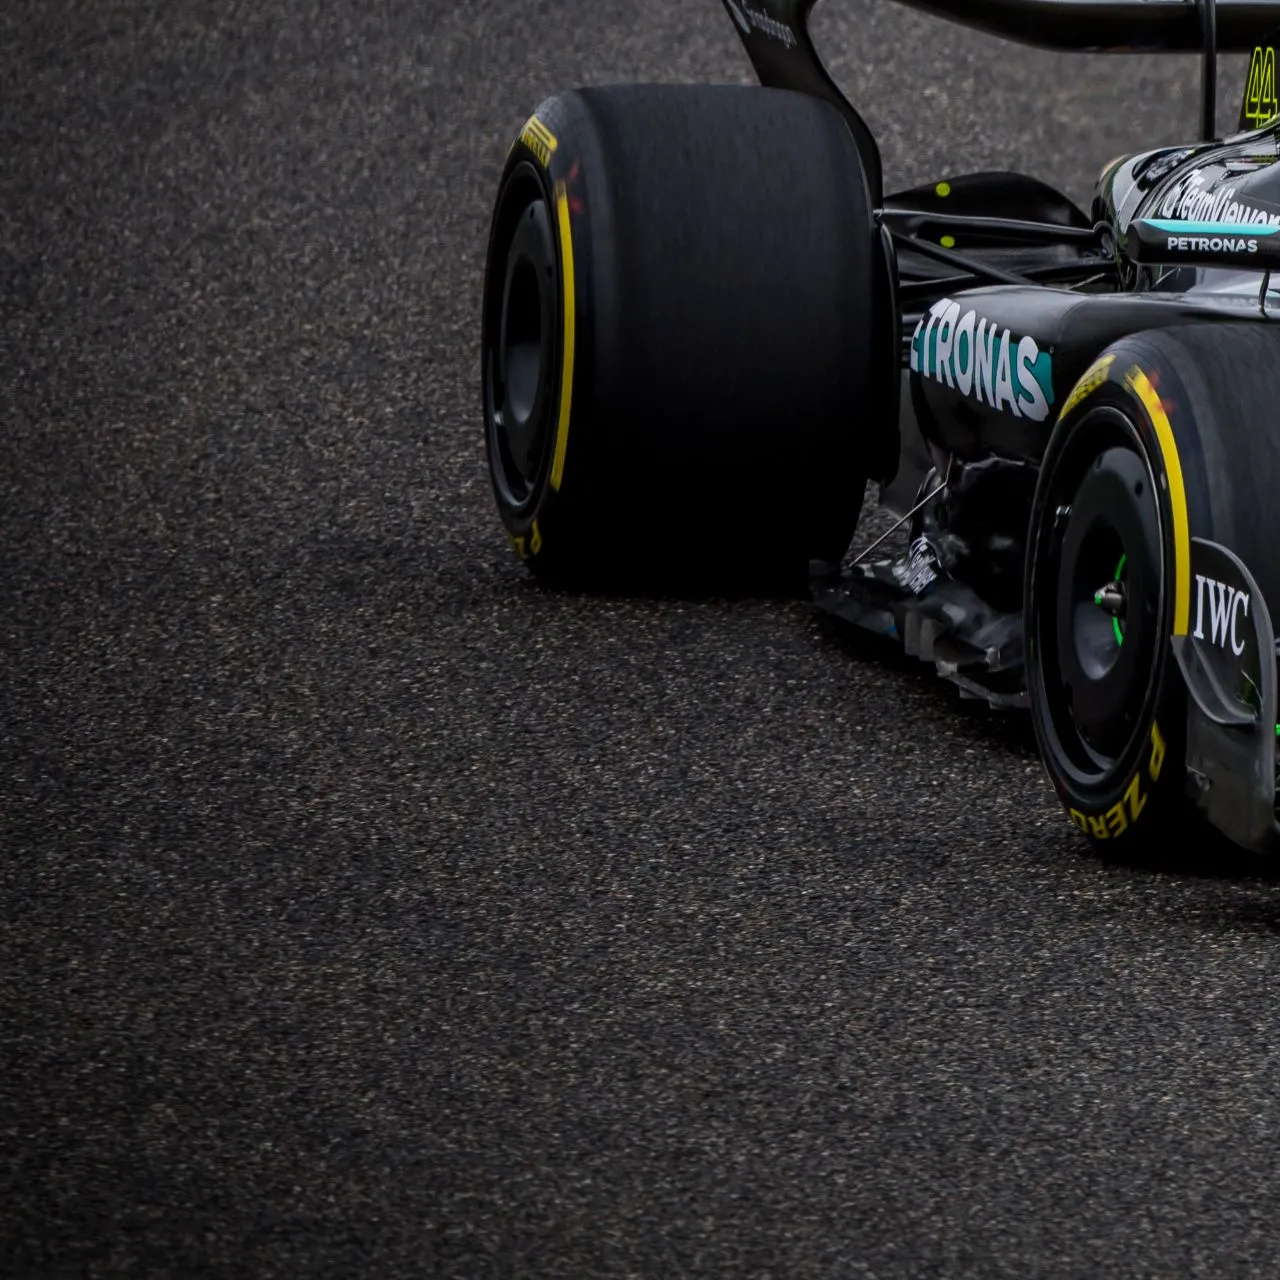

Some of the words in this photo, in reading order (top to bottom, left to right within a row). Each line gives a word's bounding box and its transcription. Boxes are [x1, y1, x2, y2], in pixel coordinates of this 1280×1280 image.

[1245, 46, 1278, 128] 44
[1167, 236, 1259, 253] PETRONAS
[910, 297, 1050, 422] ETRONAS
[1193, 573, 1250, 657] IWC
